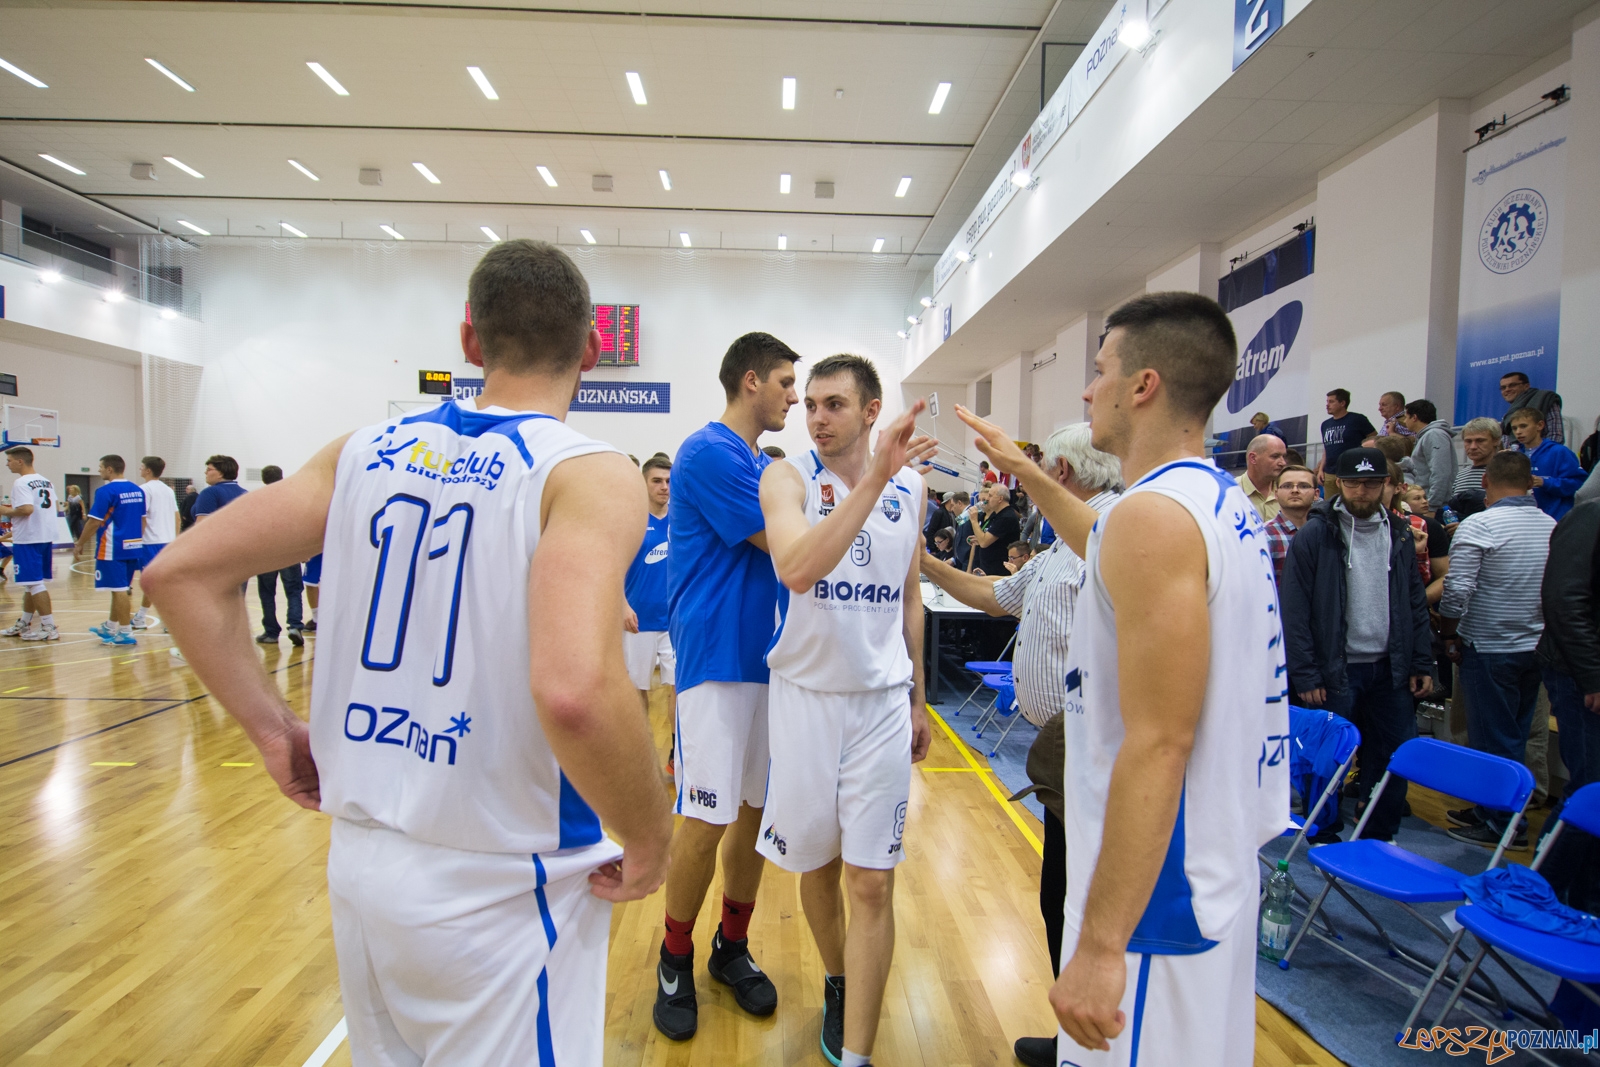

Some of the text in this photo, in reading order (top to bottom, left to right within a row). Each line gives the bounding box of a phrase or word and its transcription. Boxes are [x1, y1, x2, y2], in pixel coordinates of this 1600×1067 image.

[1235, 343, 1286, 381] atrem
[578, 387, 660, 405] OZNAŃSKA
[38, 489, 52, 509] 3
[850, 530, 872, 567] 8
[361, 493, 474, 687] 11
[697, 789, 717, 809] PBG
